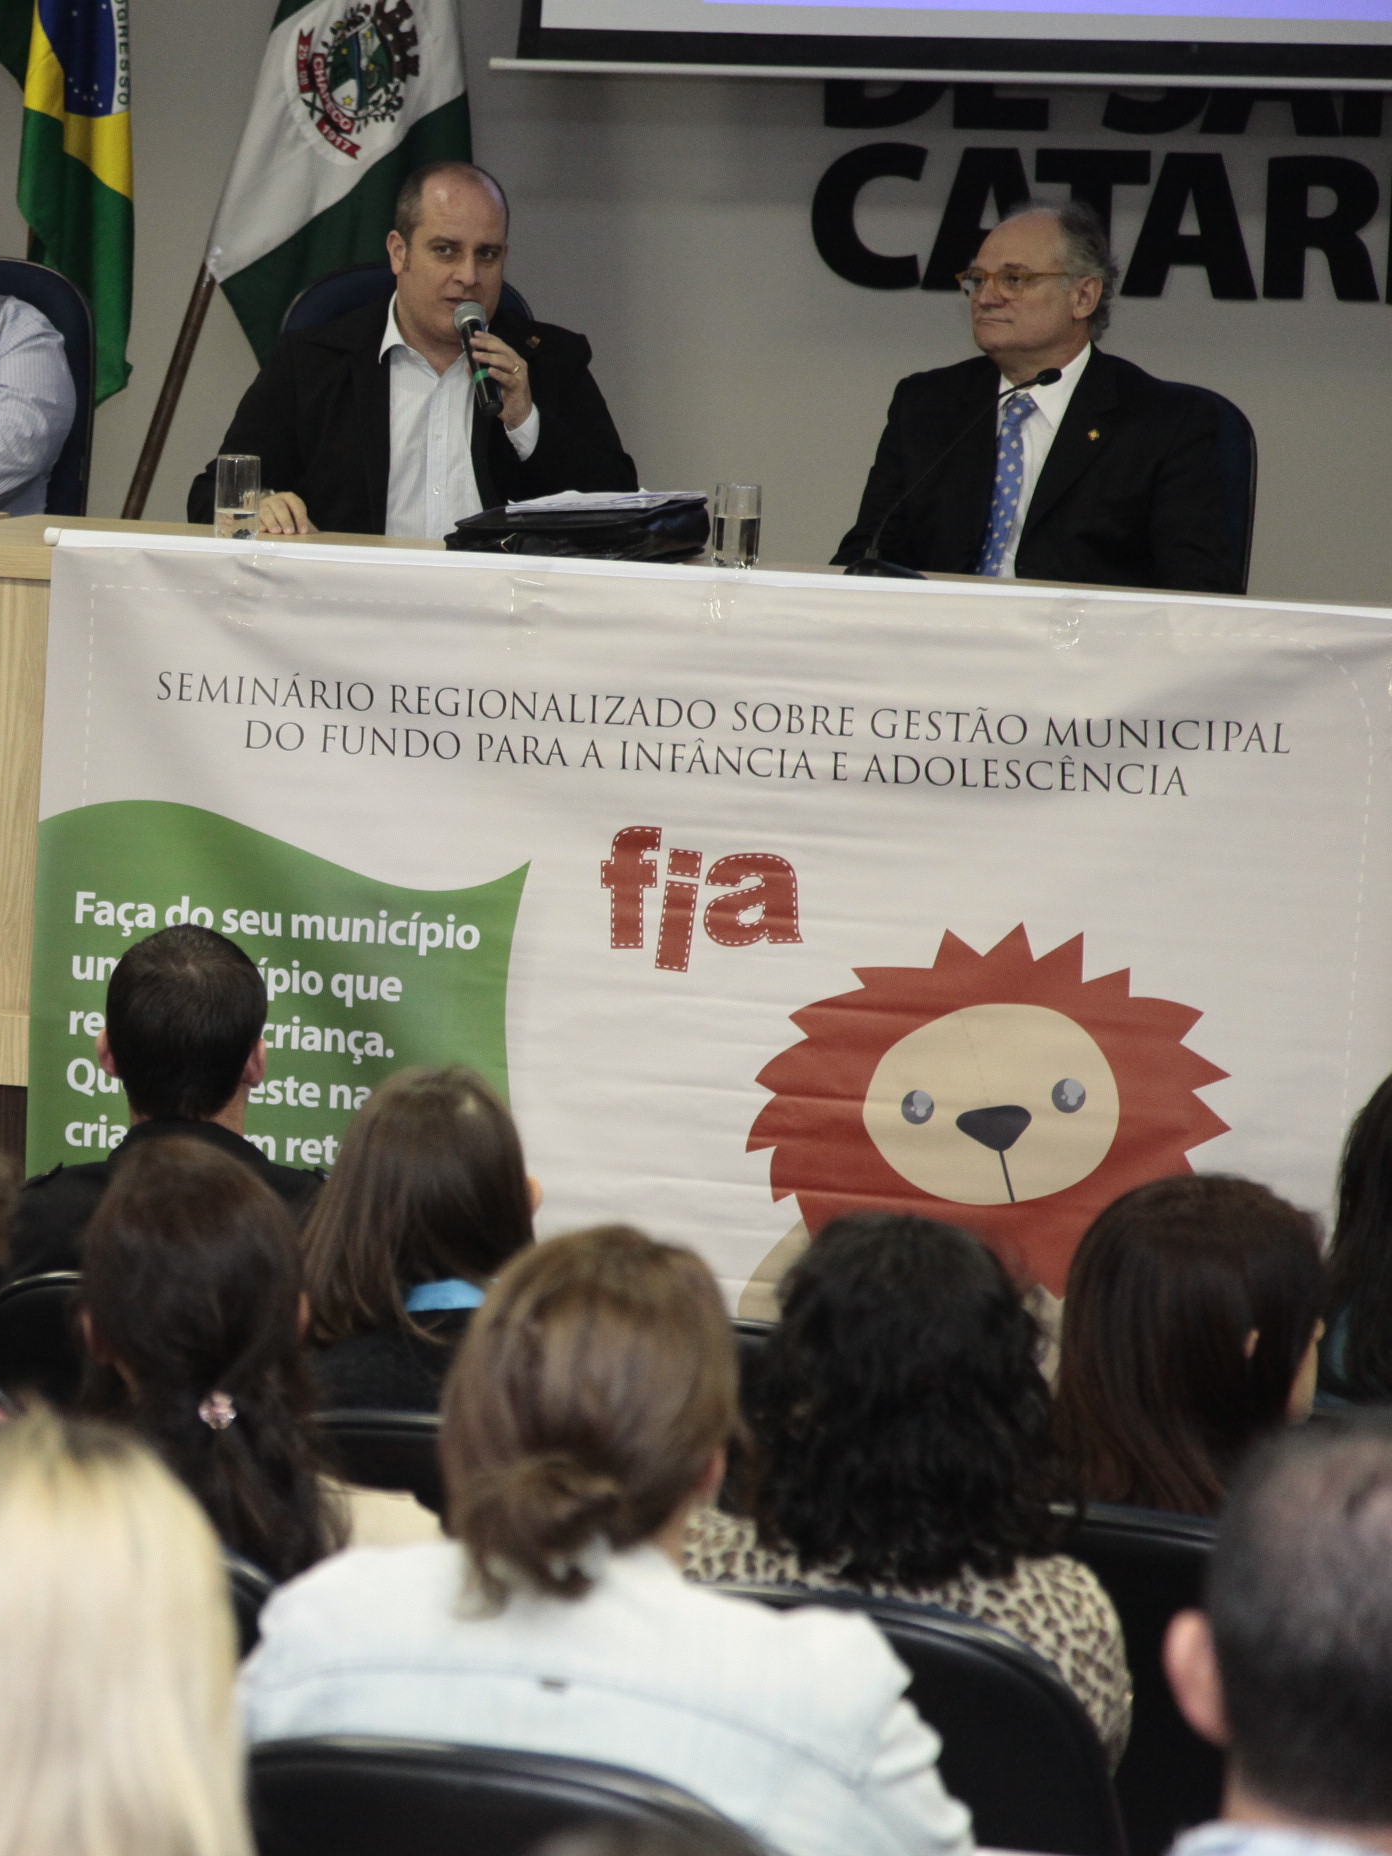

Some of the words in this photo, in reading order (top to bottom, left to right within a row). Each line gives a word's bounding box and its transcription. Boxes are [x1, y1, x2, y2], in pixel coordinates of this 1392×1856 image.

[115, 0, 129, 105] GRESSO
[811, 142, 1392, 304] CATAR
[156, 671, 375, 712] SEMINÁRIO
[390, 684, 717, 730] REGIONALIZADO
[732, 701, 855, 737] SOBRE
[870, 706, 1028, 746] GESTÃO
[1043, 716, 1291, 755] MUNICIPAL
[244, 719, 305, 752] DO
[320, 724, 461, 761] FUNDO
[476, 732, 570, 768] PARA
[580, 738, 606, 770] A
[619, 737, 817, 781] INFÂNCIA
[831, 750, 849, 782] E
[861, 753, 1189, 797] ADOLESCÊNCIA
[74, 891, 157, 937] Faça
[164, 895, 215, 929] do
[221, 908, 283, 937] seu
[291, 909, 481, 957] município
[330, 972, 403, 1008] que
[260, 1015, 395, 1065] criança.
